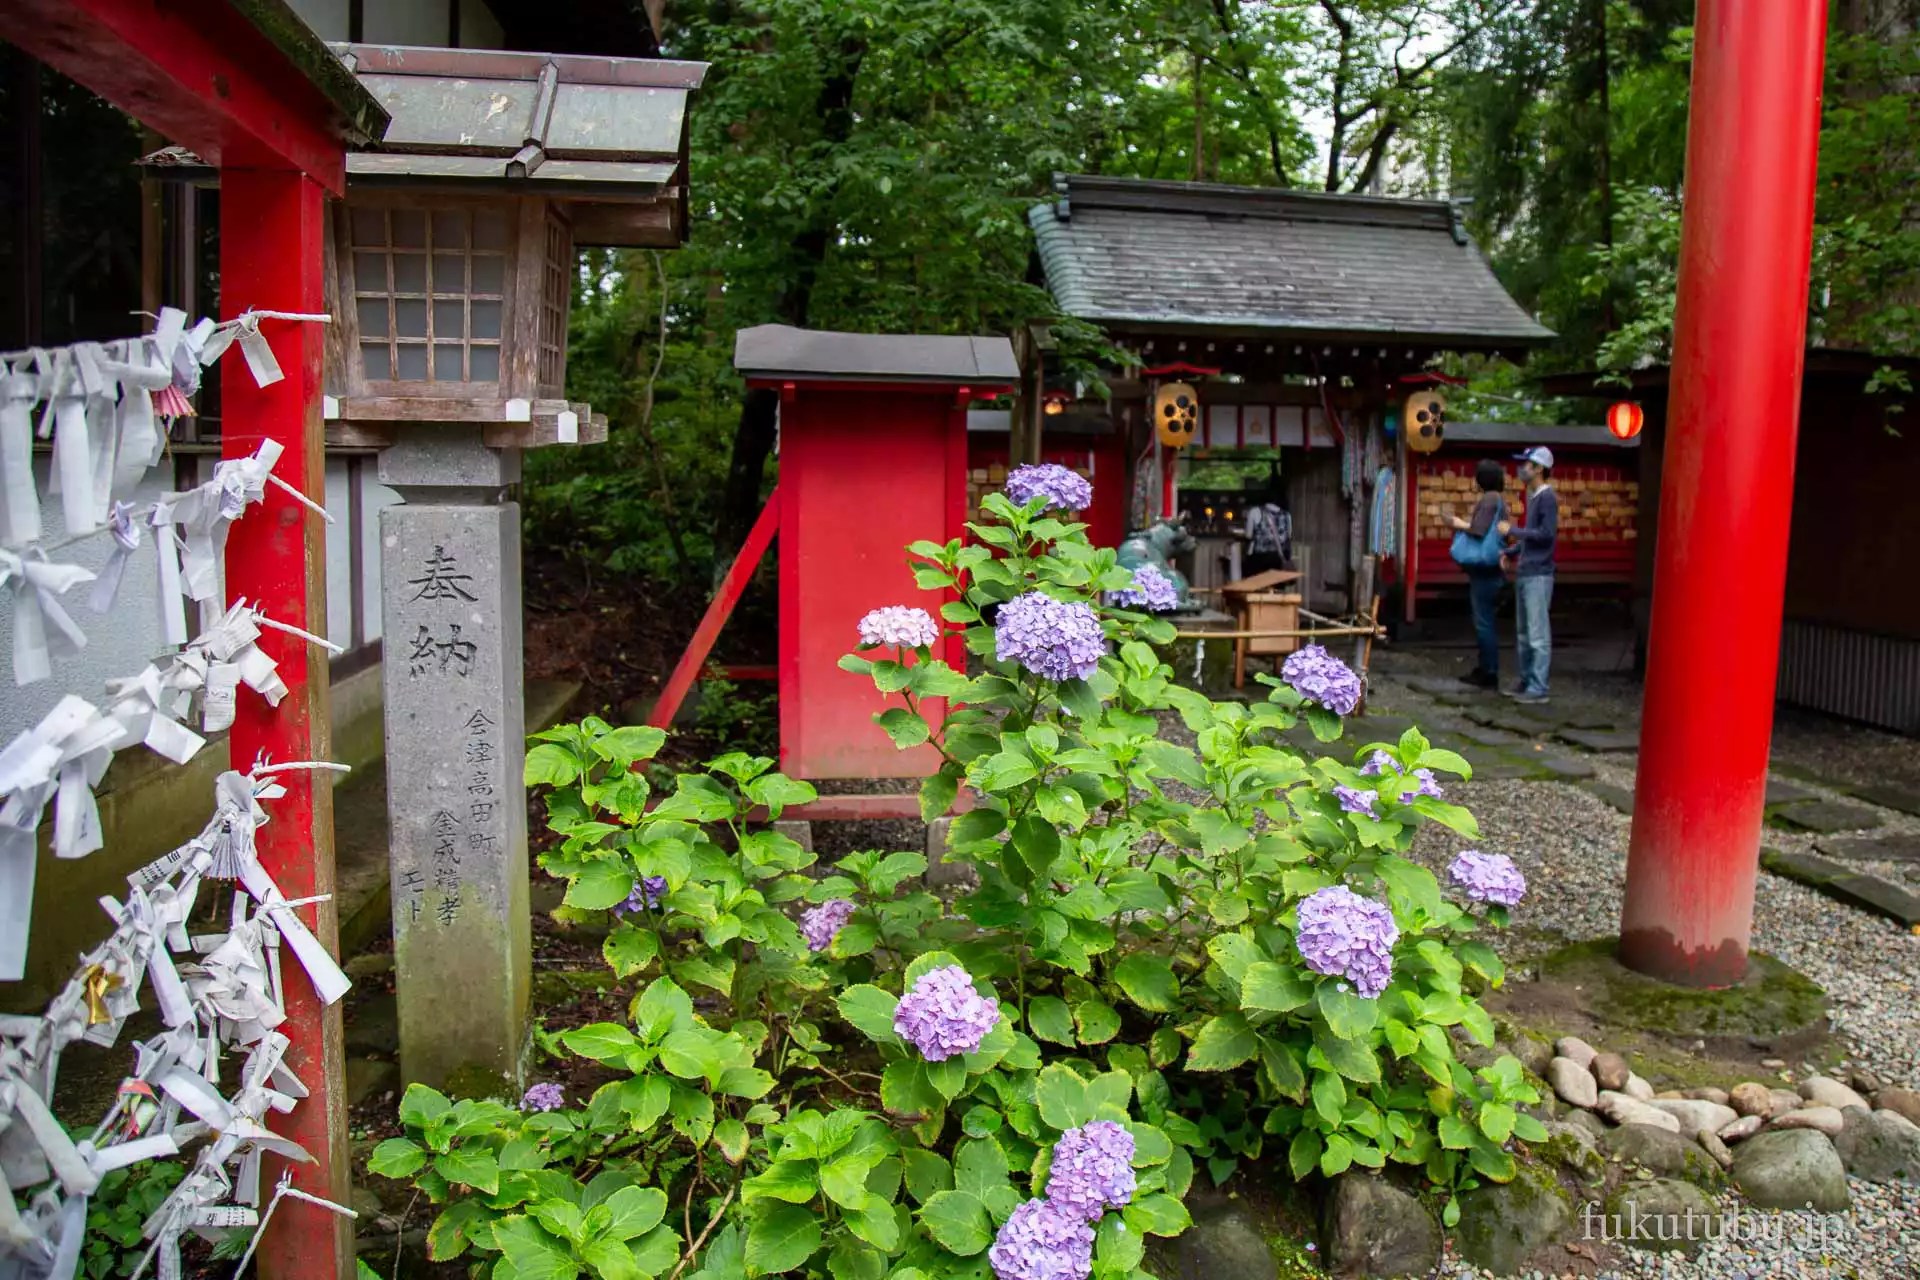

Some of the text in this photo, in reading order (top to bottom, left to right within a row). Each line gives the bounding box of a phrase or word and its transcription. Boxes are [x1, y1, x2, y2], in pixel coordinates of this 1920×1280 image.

[408, 545, 478, 678] 奉納
[464, 709, 496, 855] 会津高田町
